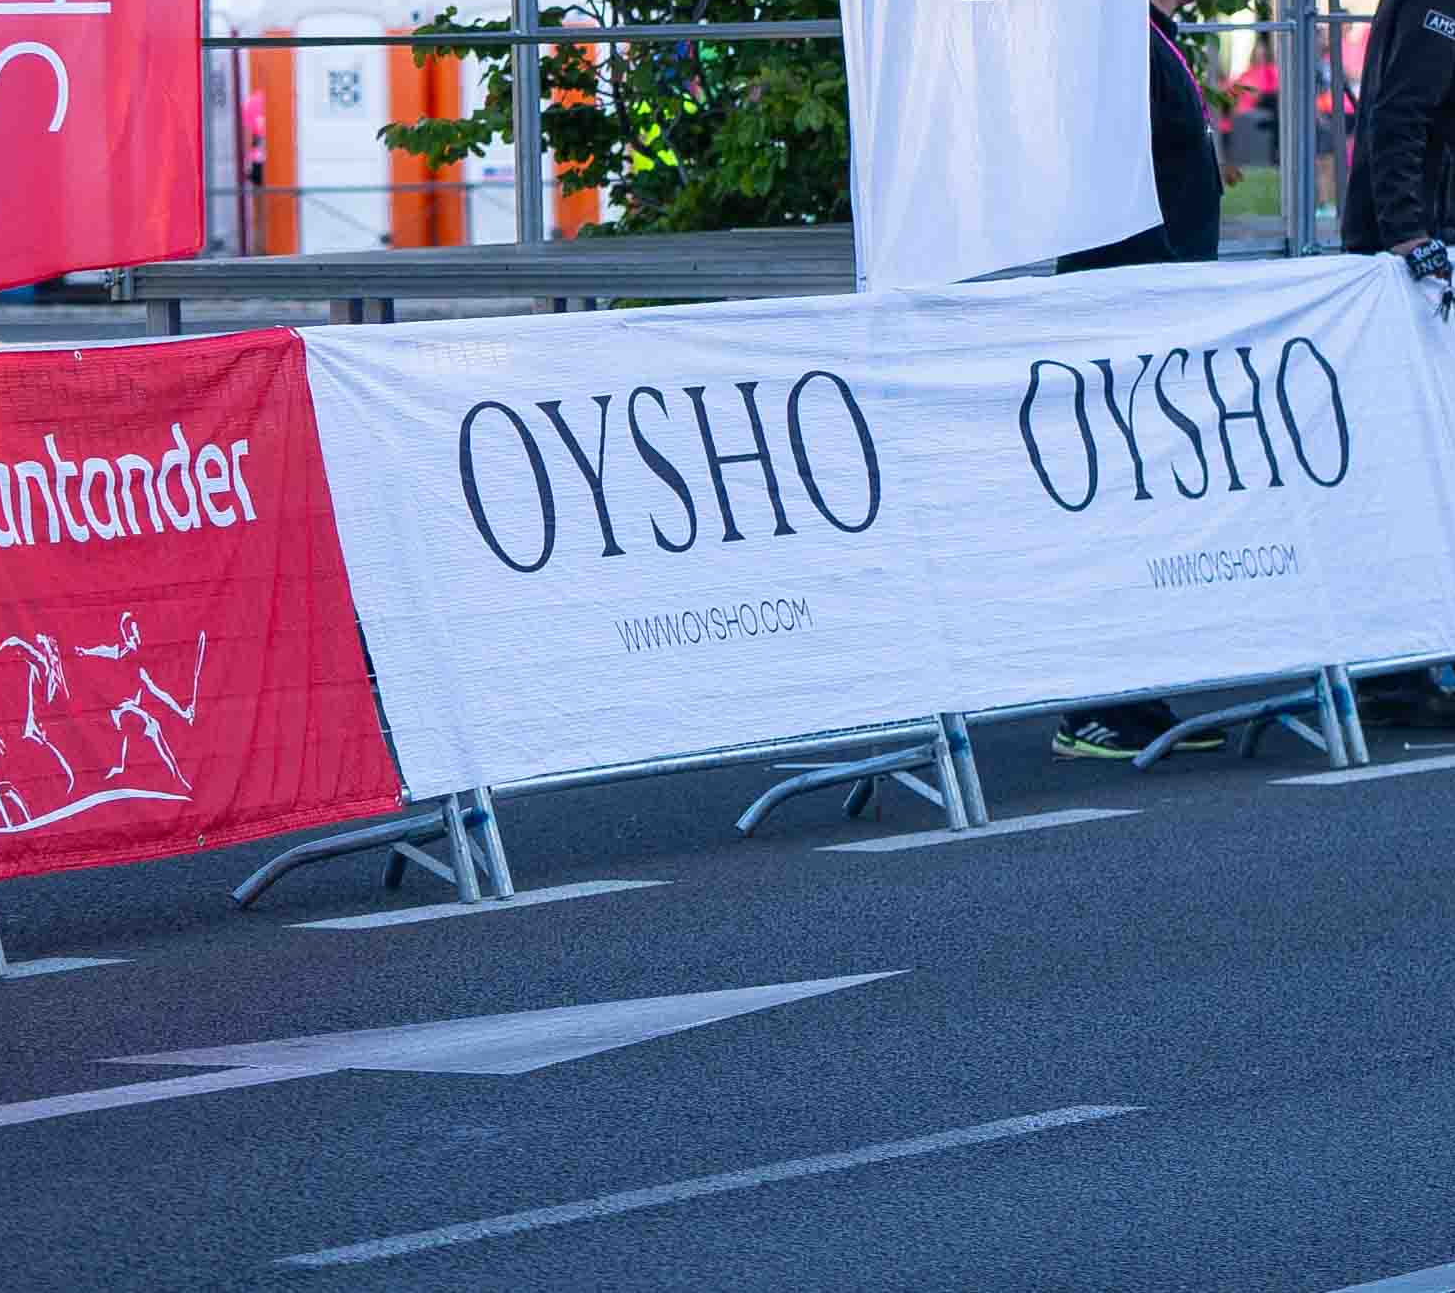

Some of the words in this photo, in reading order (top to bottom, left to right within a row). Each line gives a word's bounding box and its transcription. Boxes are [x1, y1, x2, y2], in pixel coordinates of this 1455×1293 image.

[458, 369, 882, 574] OYSHO
[1018, 336, 1350, 512] OYSHO
[615, 597, 814, 654] WWW.OYSHO.COM
[1147, 544, 1299, 591] WWW.OYSHO.COM
